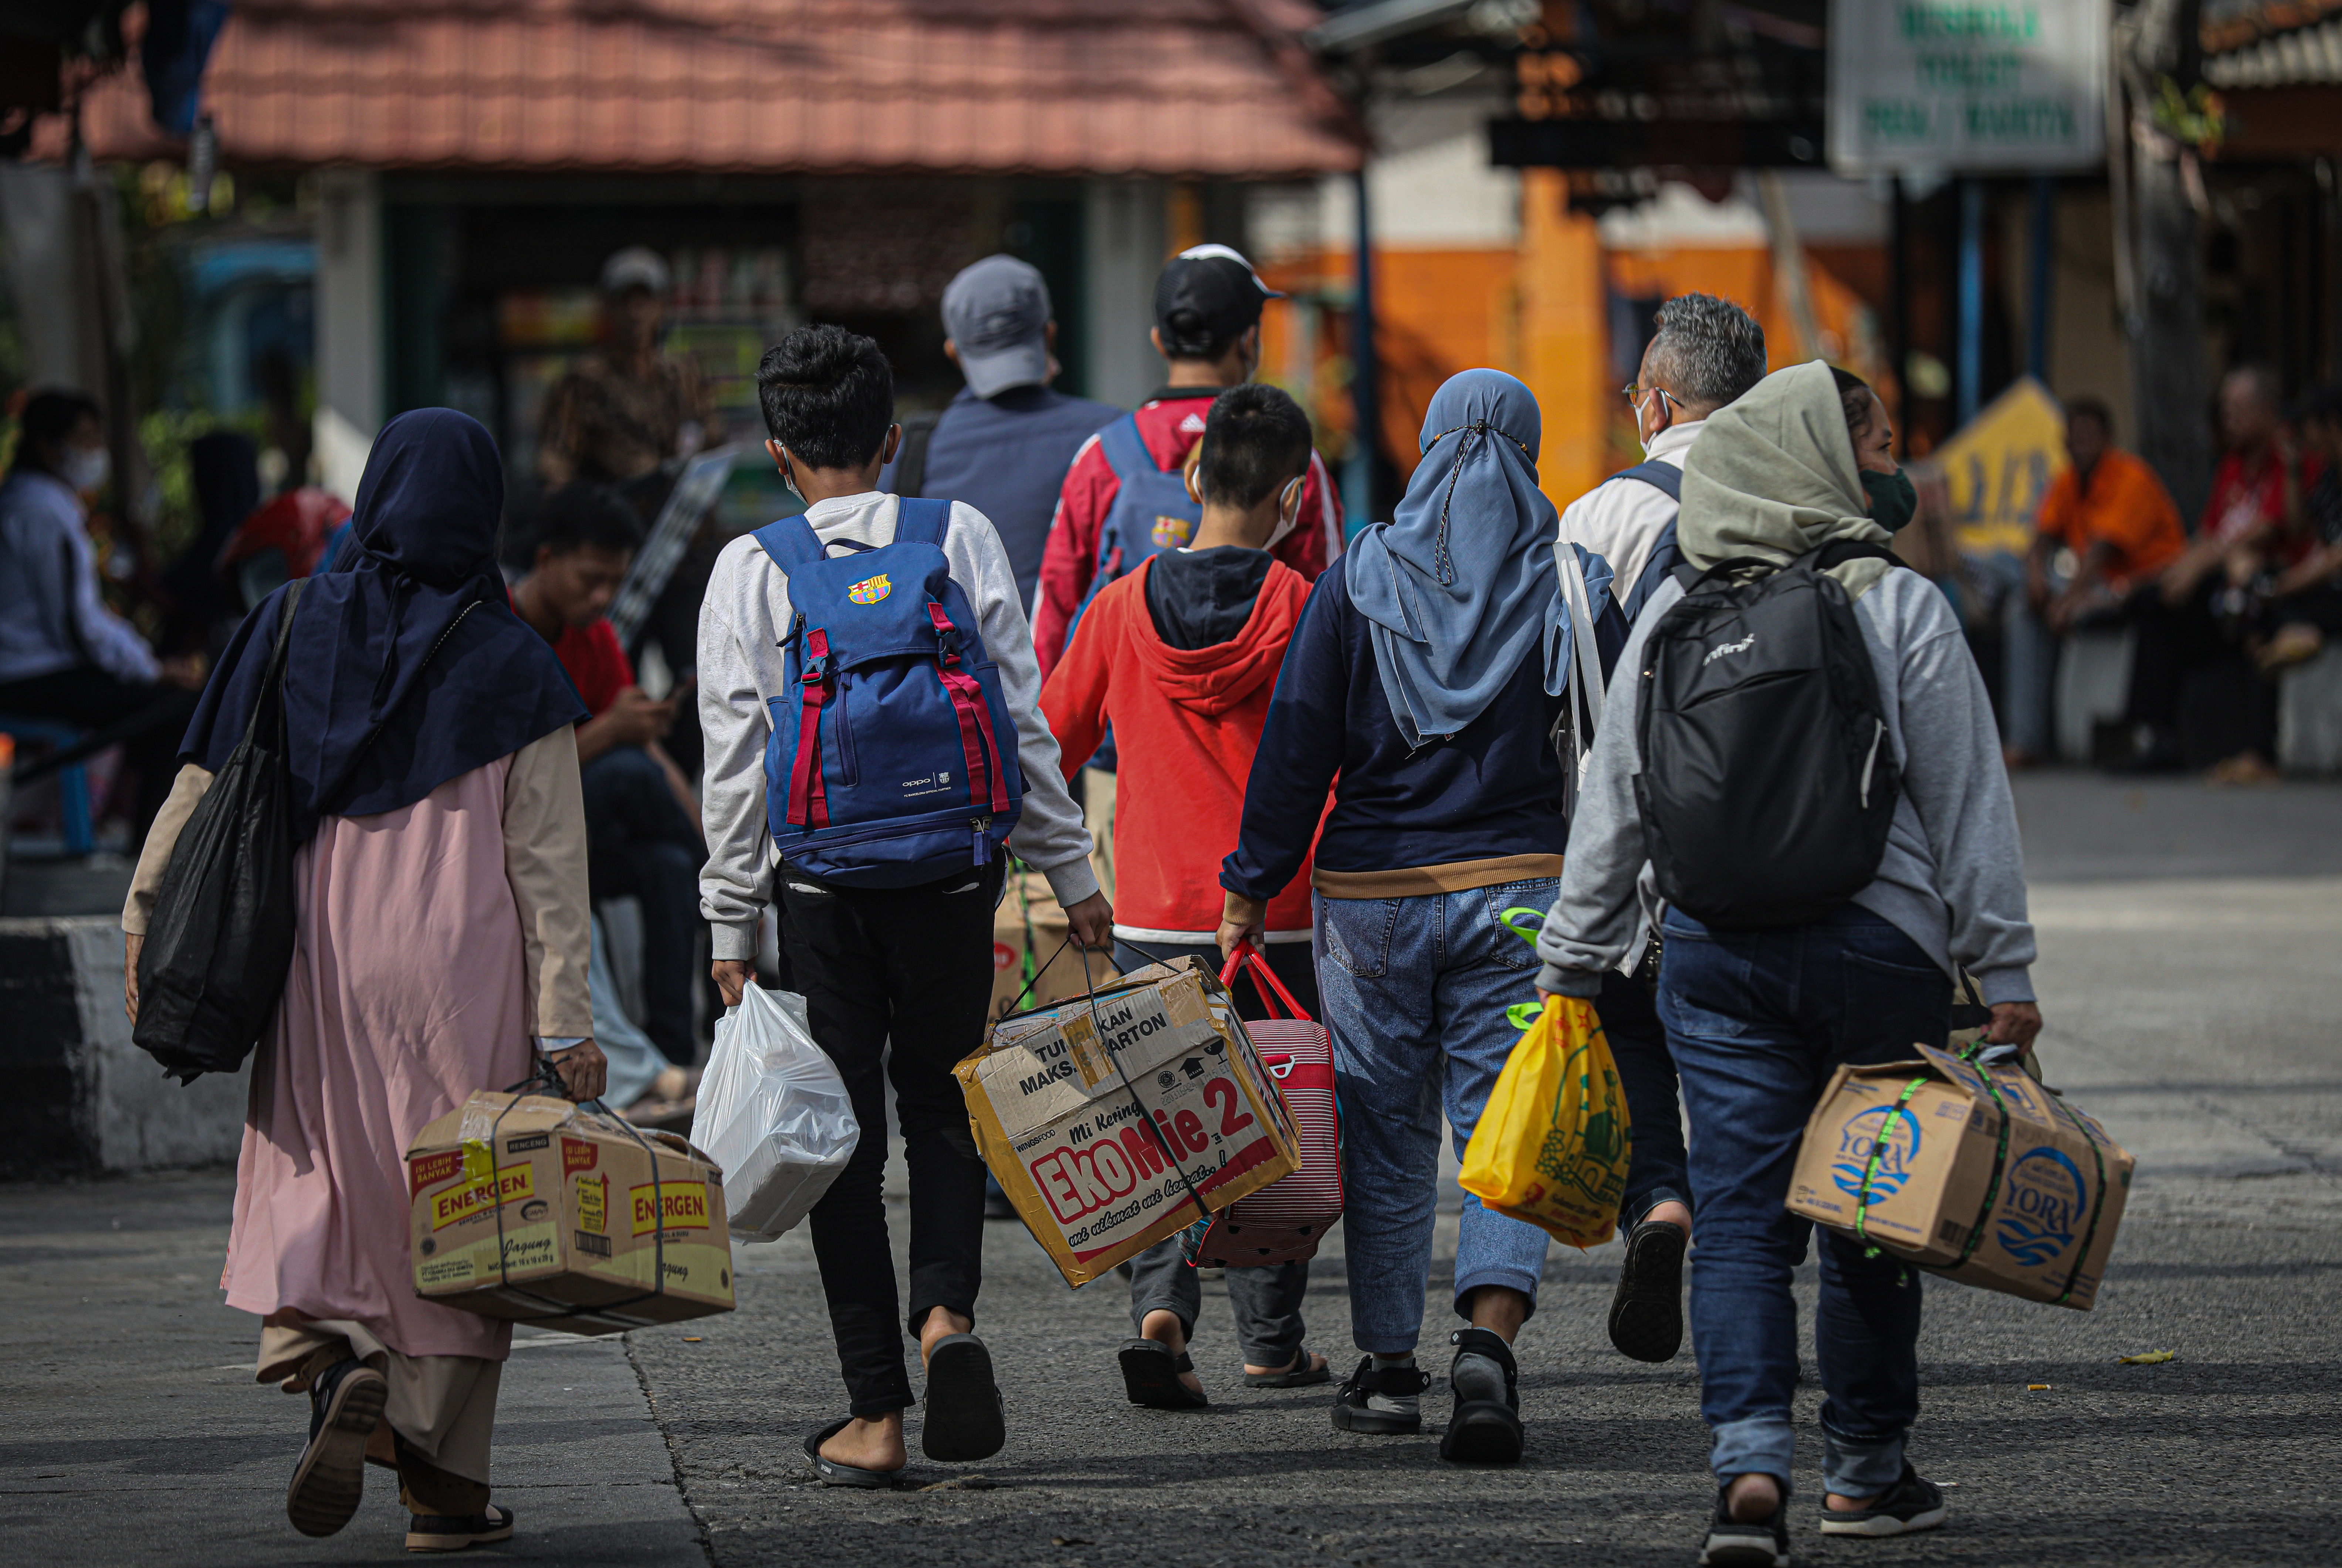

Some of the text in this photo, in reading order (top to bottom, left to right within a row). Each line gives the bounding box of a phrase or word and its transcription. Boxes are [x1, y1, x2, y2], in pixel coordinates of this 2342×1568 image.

[902, 778, 931, 787] oppo
[1019, 1060, 1078, 1096] MAKS.
[1189, 1068, 1202, 1077] atas
[1203, 1077, 1254, 1137] 2
[1069, 1102, 1141, 1145] Mi Kering
[574, 1146, 590, 1154] LEBIH
[1016, 1129, 1056, 1153] WINGSFOOD
[416, 1155, 451, 1174] ISI LEBIH
[567, 1156, 590, 1165] BANYAK
[417, 1165, 451, 1183] BANYAK
[438, 1173, 526, 1219] ENERGEN
[2006, 1177, 2069, 1233] YORA
[488, 1205, 505, 1215] SUU
[1068, 1227, 1090, 1247] mi
[1090, 1200, 1141, 1236] nikmat
[1142, 1188, 1163, 1210] mi
[504, 1238, 552, 1258] Jagung
[488, 1260, 517, 1272] Isi/Cotent:
[662, 1262, 688, 1282] agung
